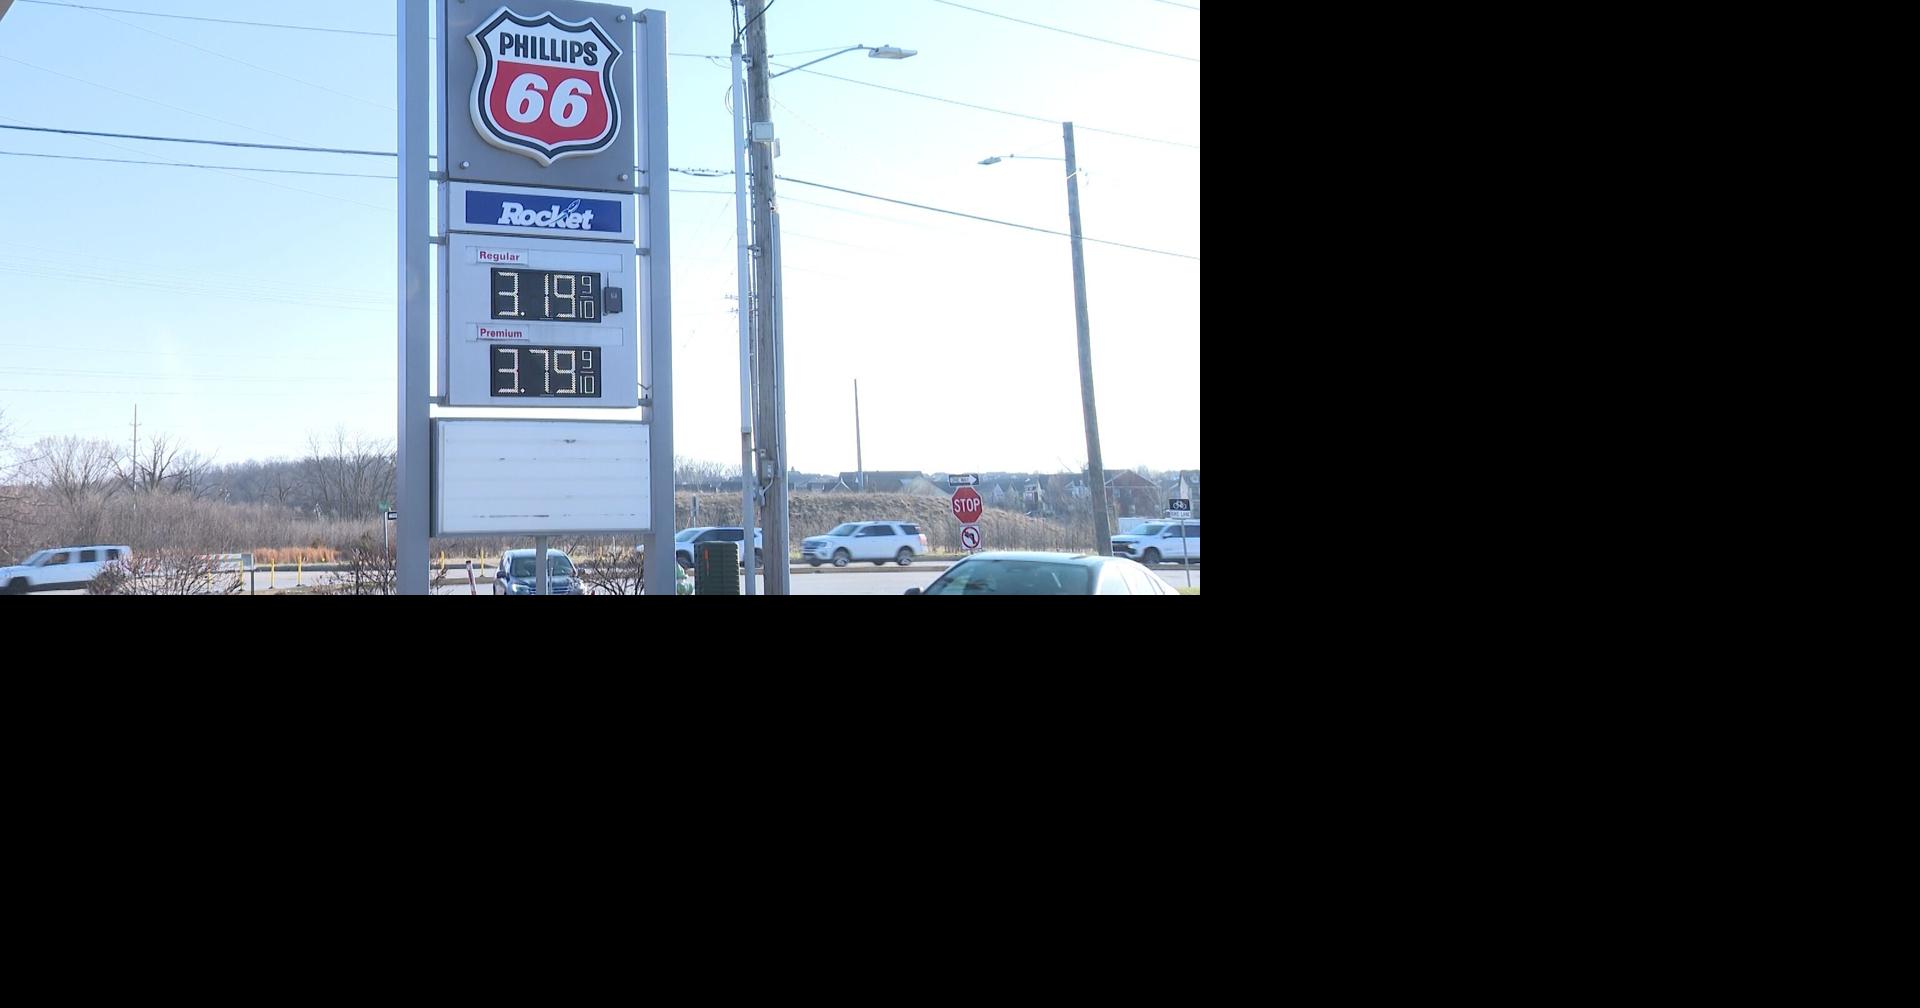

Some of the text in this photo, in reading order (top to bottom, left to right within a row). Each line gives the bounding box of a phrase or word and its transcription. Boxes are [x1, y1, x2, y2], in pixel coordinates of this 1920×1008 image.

[500, 32, 598, 66] PHILLIPS
[505, 72, 593, 128] 66
[497, 201, 594, 230] Rocket
[479, 251, 520, 262] Regular
[498, 271, 577, 318] 3.19
[480, 328, 523, 338] Premium
[498, 348, 577, 394] 3.79
[954, 498, 980, 513] STOP
